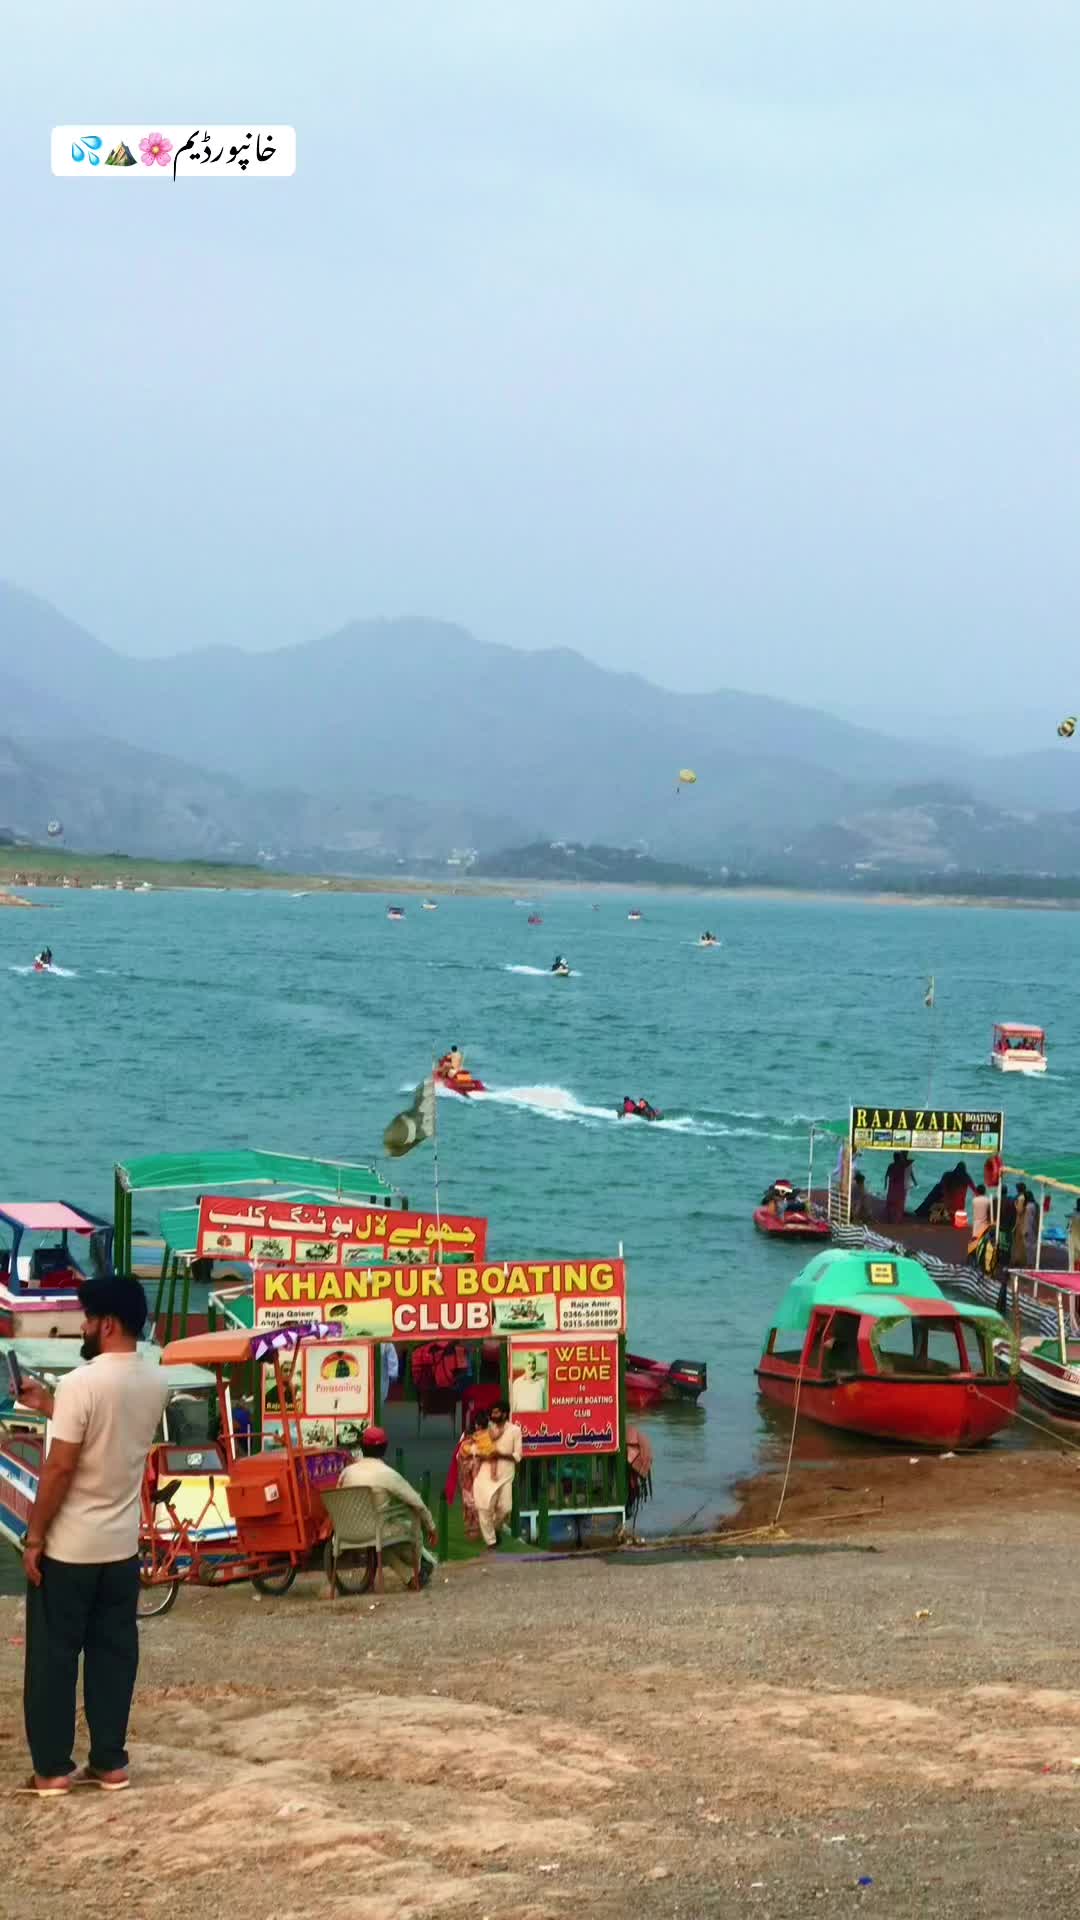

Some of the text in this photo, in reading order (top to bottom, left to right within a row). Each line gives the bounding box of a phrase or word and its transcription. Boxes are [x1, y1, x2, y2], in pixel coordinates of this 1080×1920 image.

[856, 1109, 963, 1131] RAJA ZAIN
[965, 1113, 998, 1123] BOATING
[971, 1124, 991, 1132] CLUB
[208, 1205, 267, 1229] کلب
[355, 1213, 388, 1240] لال
[264, 1263, 615, 1301] KHANPUR BOATING
[570, 1301, 589, 1309] Raja
[265, 1311, 284, 1320] Raja
[393, 1302, 490, 1332] CLUB
[555, 1346, 611, 1362] WELL
[555, 1365, 611, 1382] COME
[551, 1396, 614, 1405] KHANPUR BOATING
[573, 1409, 591, 1418] CLUB
